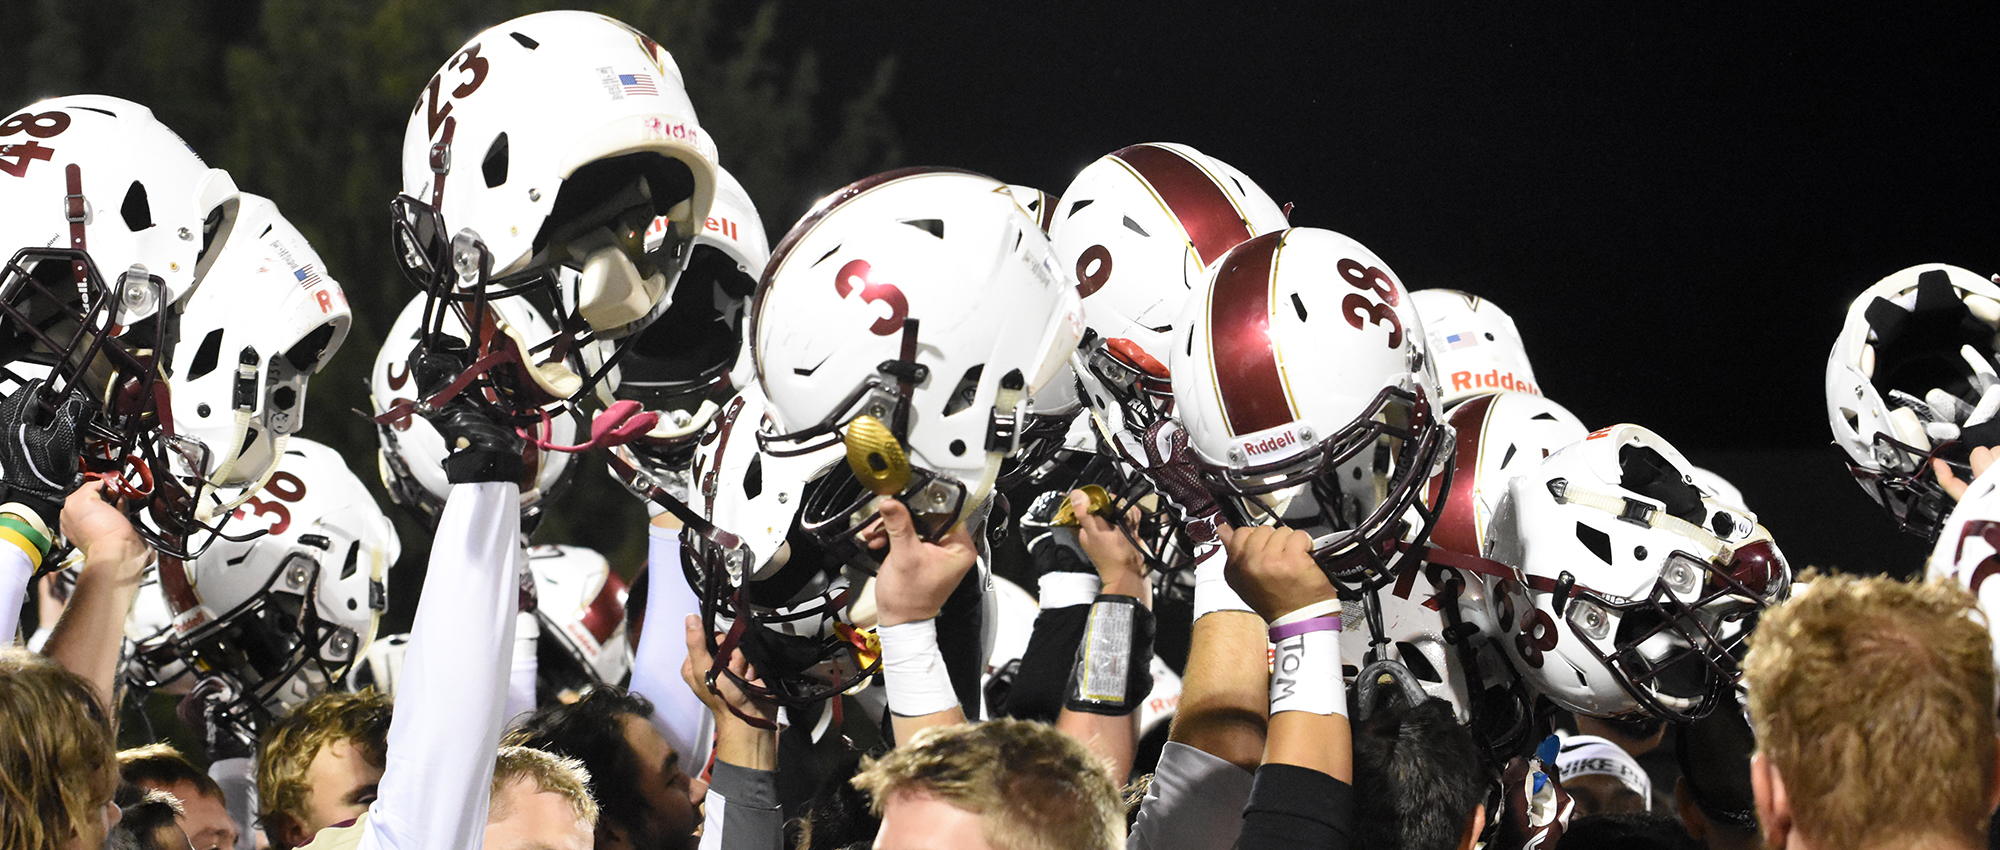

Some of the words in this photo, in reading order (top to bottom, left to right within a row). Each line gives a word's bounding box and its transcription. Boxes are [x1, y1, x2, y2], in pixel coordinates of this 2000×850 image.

[414, 43, 489, 142] 23
[0, 111, 71, 178] 48
[835, 259, 909, 336] 3
[1336, 257, 1400, 350] 38
[1243, 430, 1296, 456] Riddell
[1272, 633, 1305, 705] TOM
[1559, 758, 1613, 777] NIKE
